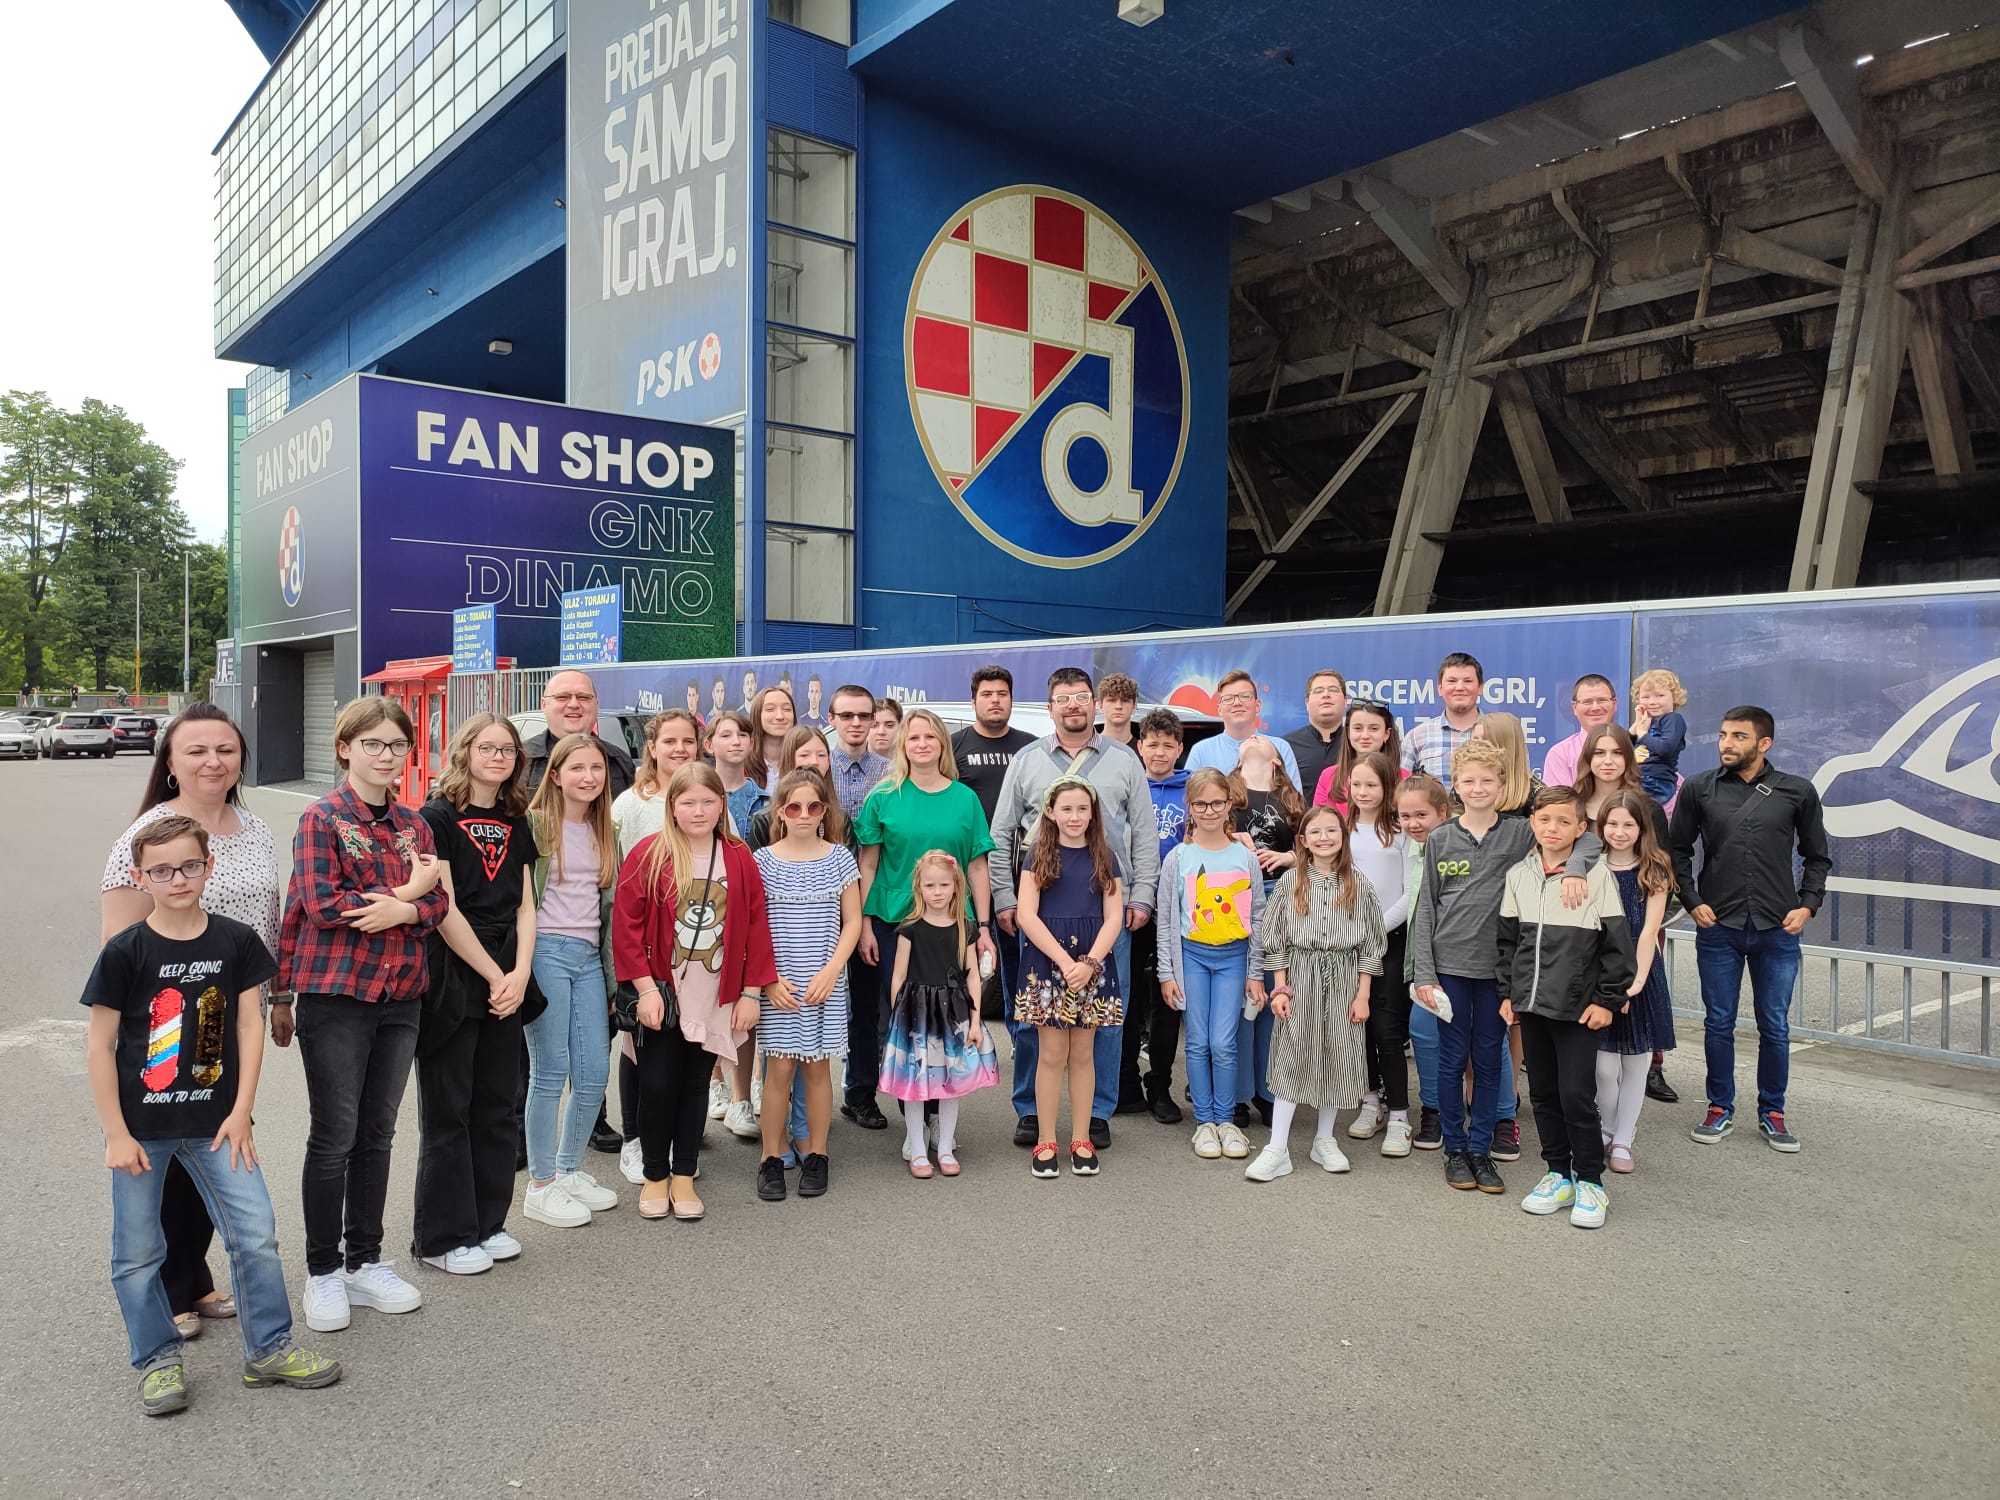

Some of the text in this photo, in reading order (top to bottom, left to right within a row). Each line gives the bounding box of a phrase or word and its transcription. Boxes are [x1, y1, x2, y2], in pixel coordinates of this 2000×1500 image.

[605, 0, 738, 104] PREDAJE!
[604, 54, 737, 202] SAMO
[602, 173, 737, 300] IGRAJ.
[636, 339, 698, 406] PSK
[256, 418, 333, 498] FAN SHOP
[417, 410, 714, 491] FAN SHOP
[589, 500, 715, 555] GNK
[564, 597, 580, 609] ULAZ
[584, 593, 610, 607] TORANJ
[638, 689, 664, 712] NEMA
[1437, 860, 1471, 877] 932
[158, 960, 223, 978] KEEP GOING
[142, 1091, 175, 1104] BORN
[175, 1090, 189, 1104] TO
